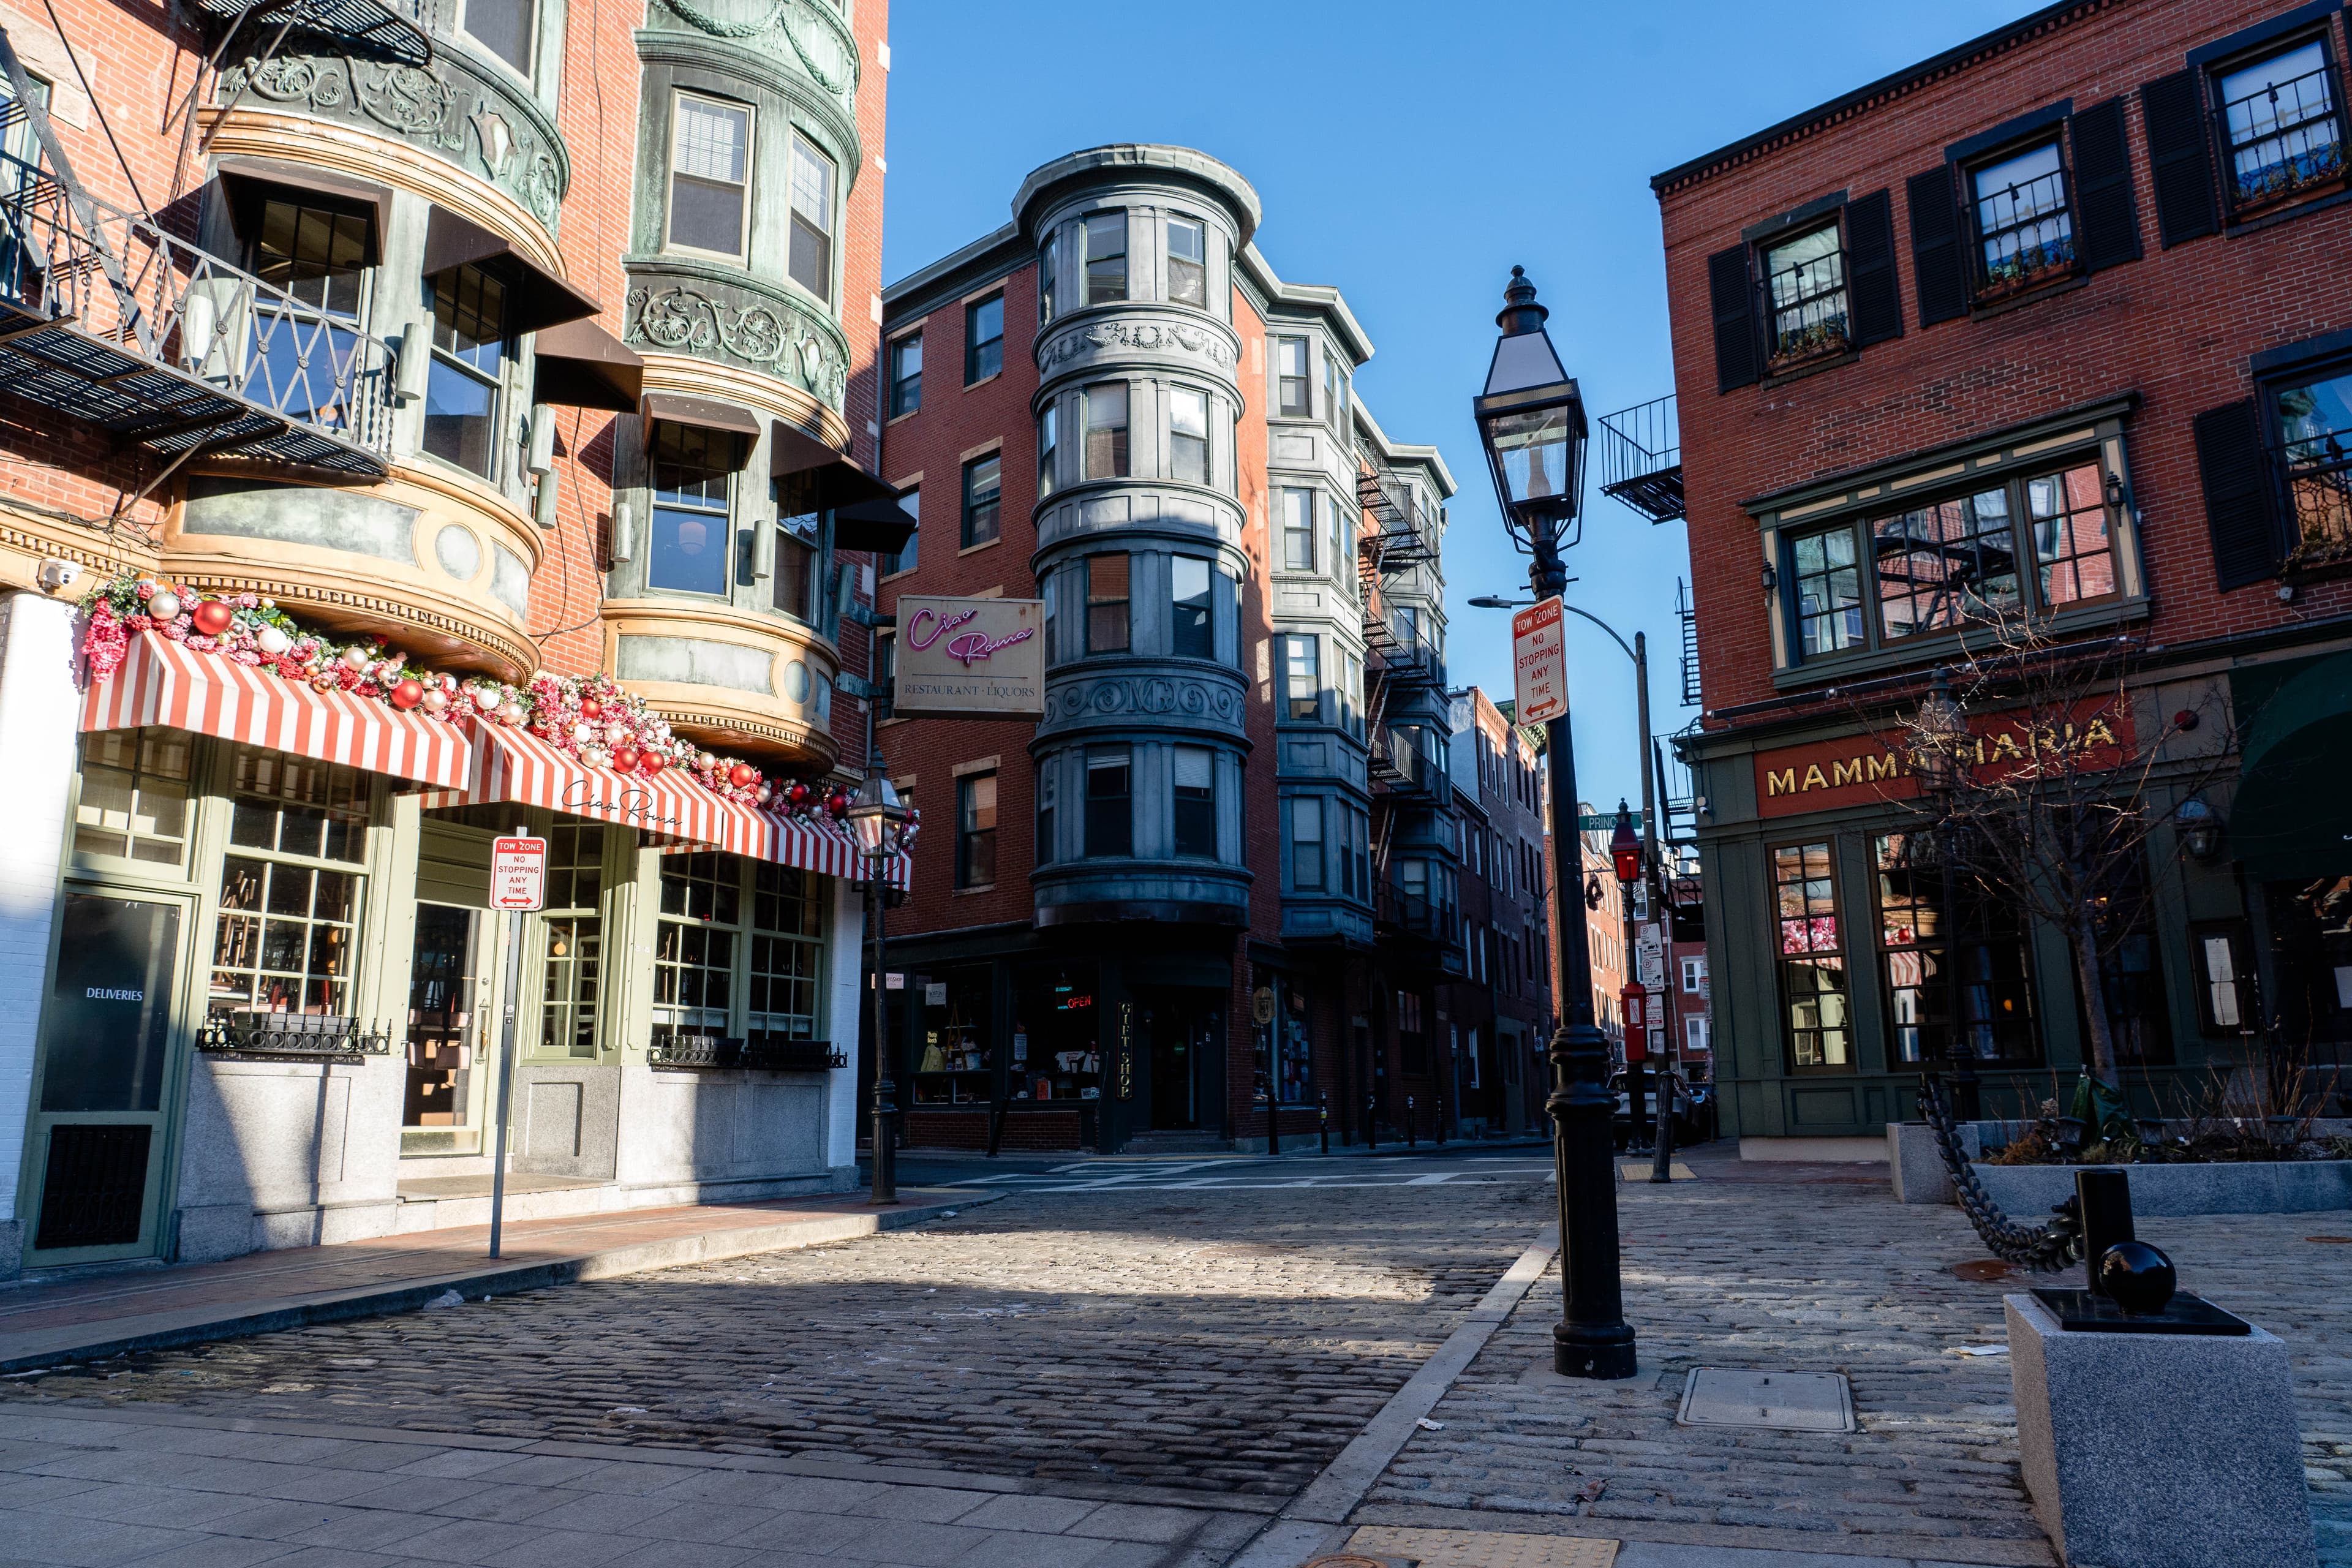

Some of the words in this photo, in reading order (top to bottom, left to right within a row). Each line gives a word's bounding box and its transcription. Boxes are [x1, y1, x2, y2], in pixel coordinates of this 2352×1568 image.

[909, 608, 978, 650] Ciao
[1516, 616, 1532, 633] TOW
[1536, 605, 1559, 624] ZONE
[947, 626, 1034, 665] Roma
[1532, 633, 1544, 647] NO
[1519, 644, 1559, 669] STOPPING
[1531, 665, 1548, 682] ANY
[905, 684, 979, 696] RESTAURANT
[987, 686, 1035, 699] LIQUORS
[1531, 682, 1550, 699] TIME
[562, 780, 618, 812] Ciao
[619, 789, 682, 826] Roma
[1589, 816, 1618, 829] PRINC
[86, 987, 143, 1001] DELIVERIES
[1068, 995, 1091, 1009] OPEN
[1121, 1003, 1131, 1047] GIFT
[1120, 1052, 1130, 1096] SHOP
